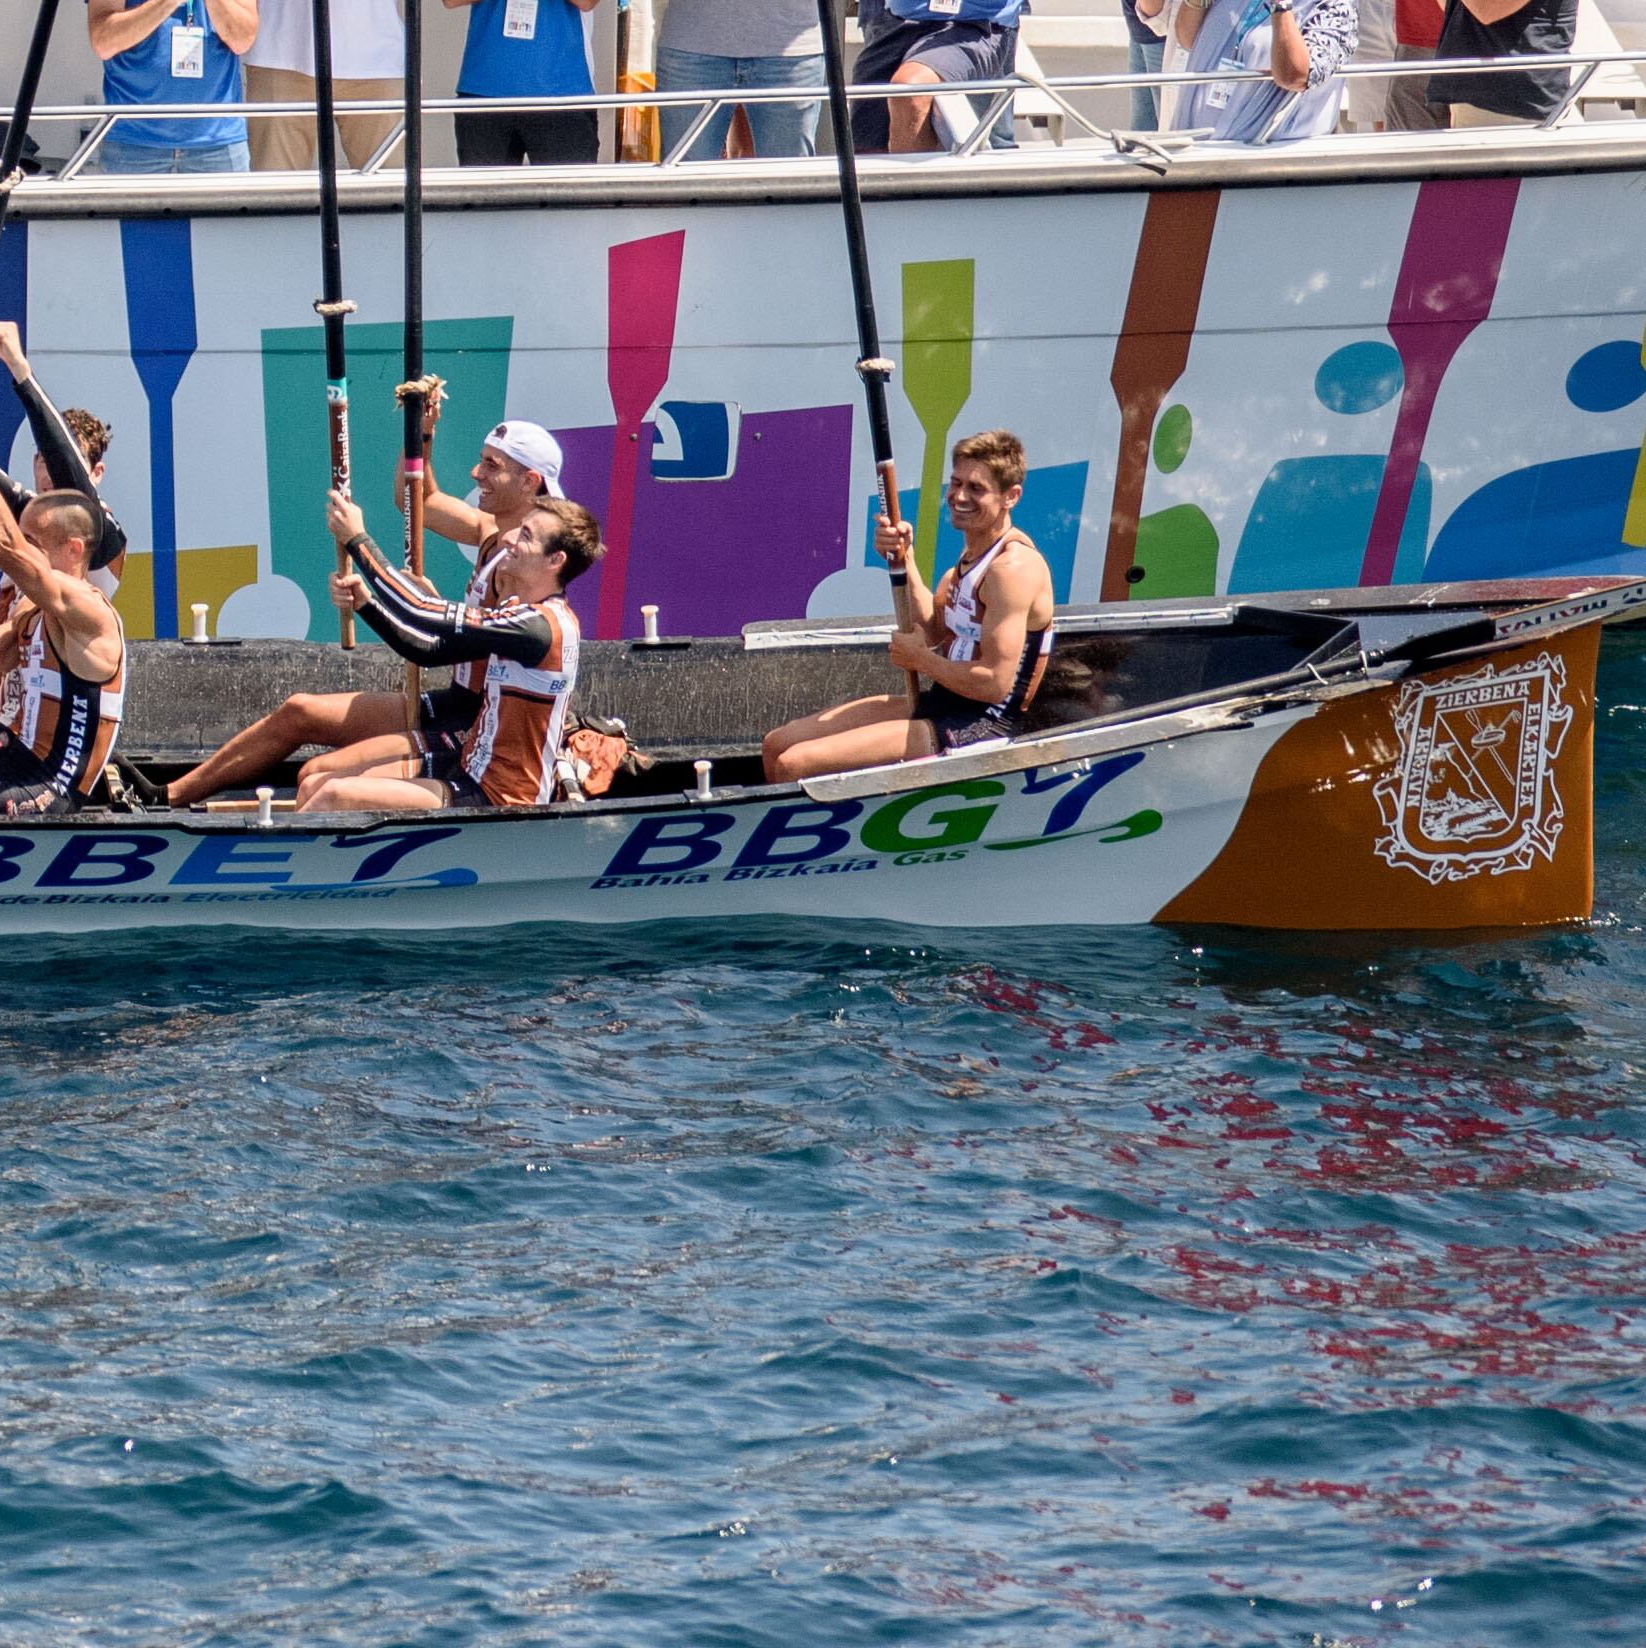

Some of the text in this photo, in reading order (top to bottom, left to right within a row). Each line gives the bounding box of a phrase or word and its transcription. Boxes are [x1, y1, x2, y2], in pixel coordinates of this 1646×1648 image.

[1517, 702, 1542, 809] ELKARTEA
[602, 751, 1147, 877] BBG7
[0, 893, 42, 906] de
[46, 891, 171, 906] Bizkaia
[184, 886, 396, 906] Electricidad
[723, 858, 879, 883] Bizkaia
[892, 849, 967, 867] Gas
